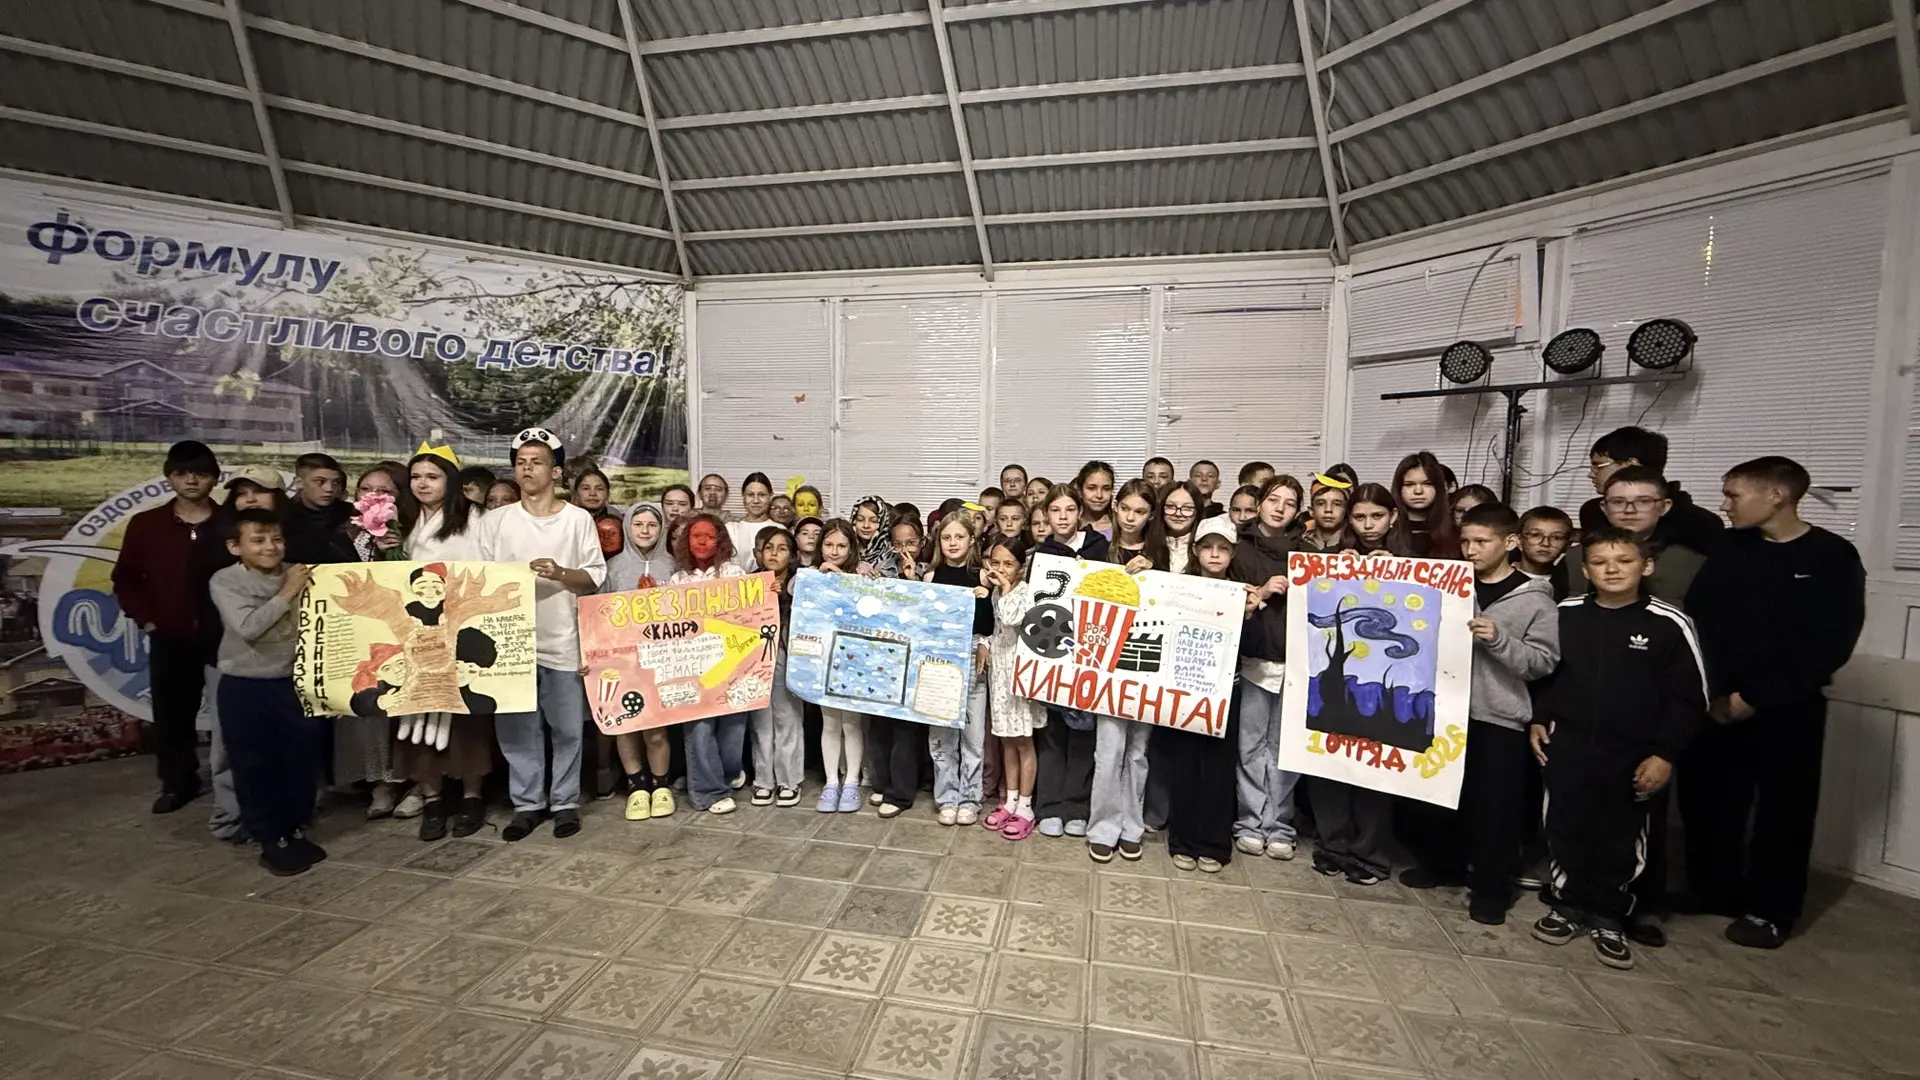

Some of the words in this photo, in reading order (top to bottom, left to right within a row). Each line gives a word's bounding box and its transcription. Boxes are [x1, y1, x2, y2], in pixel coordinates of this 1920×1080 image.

[477, 338, 672, 376] детства!
[1414, 561, 1473, 598] СЕАНС
[1178, 625, 1223, 643] ДЕВИЗ
[1012, 655, 1227, 736] КИНОЛЕНТА!
[1326, 733, 1406, 772] ОТРЯД
